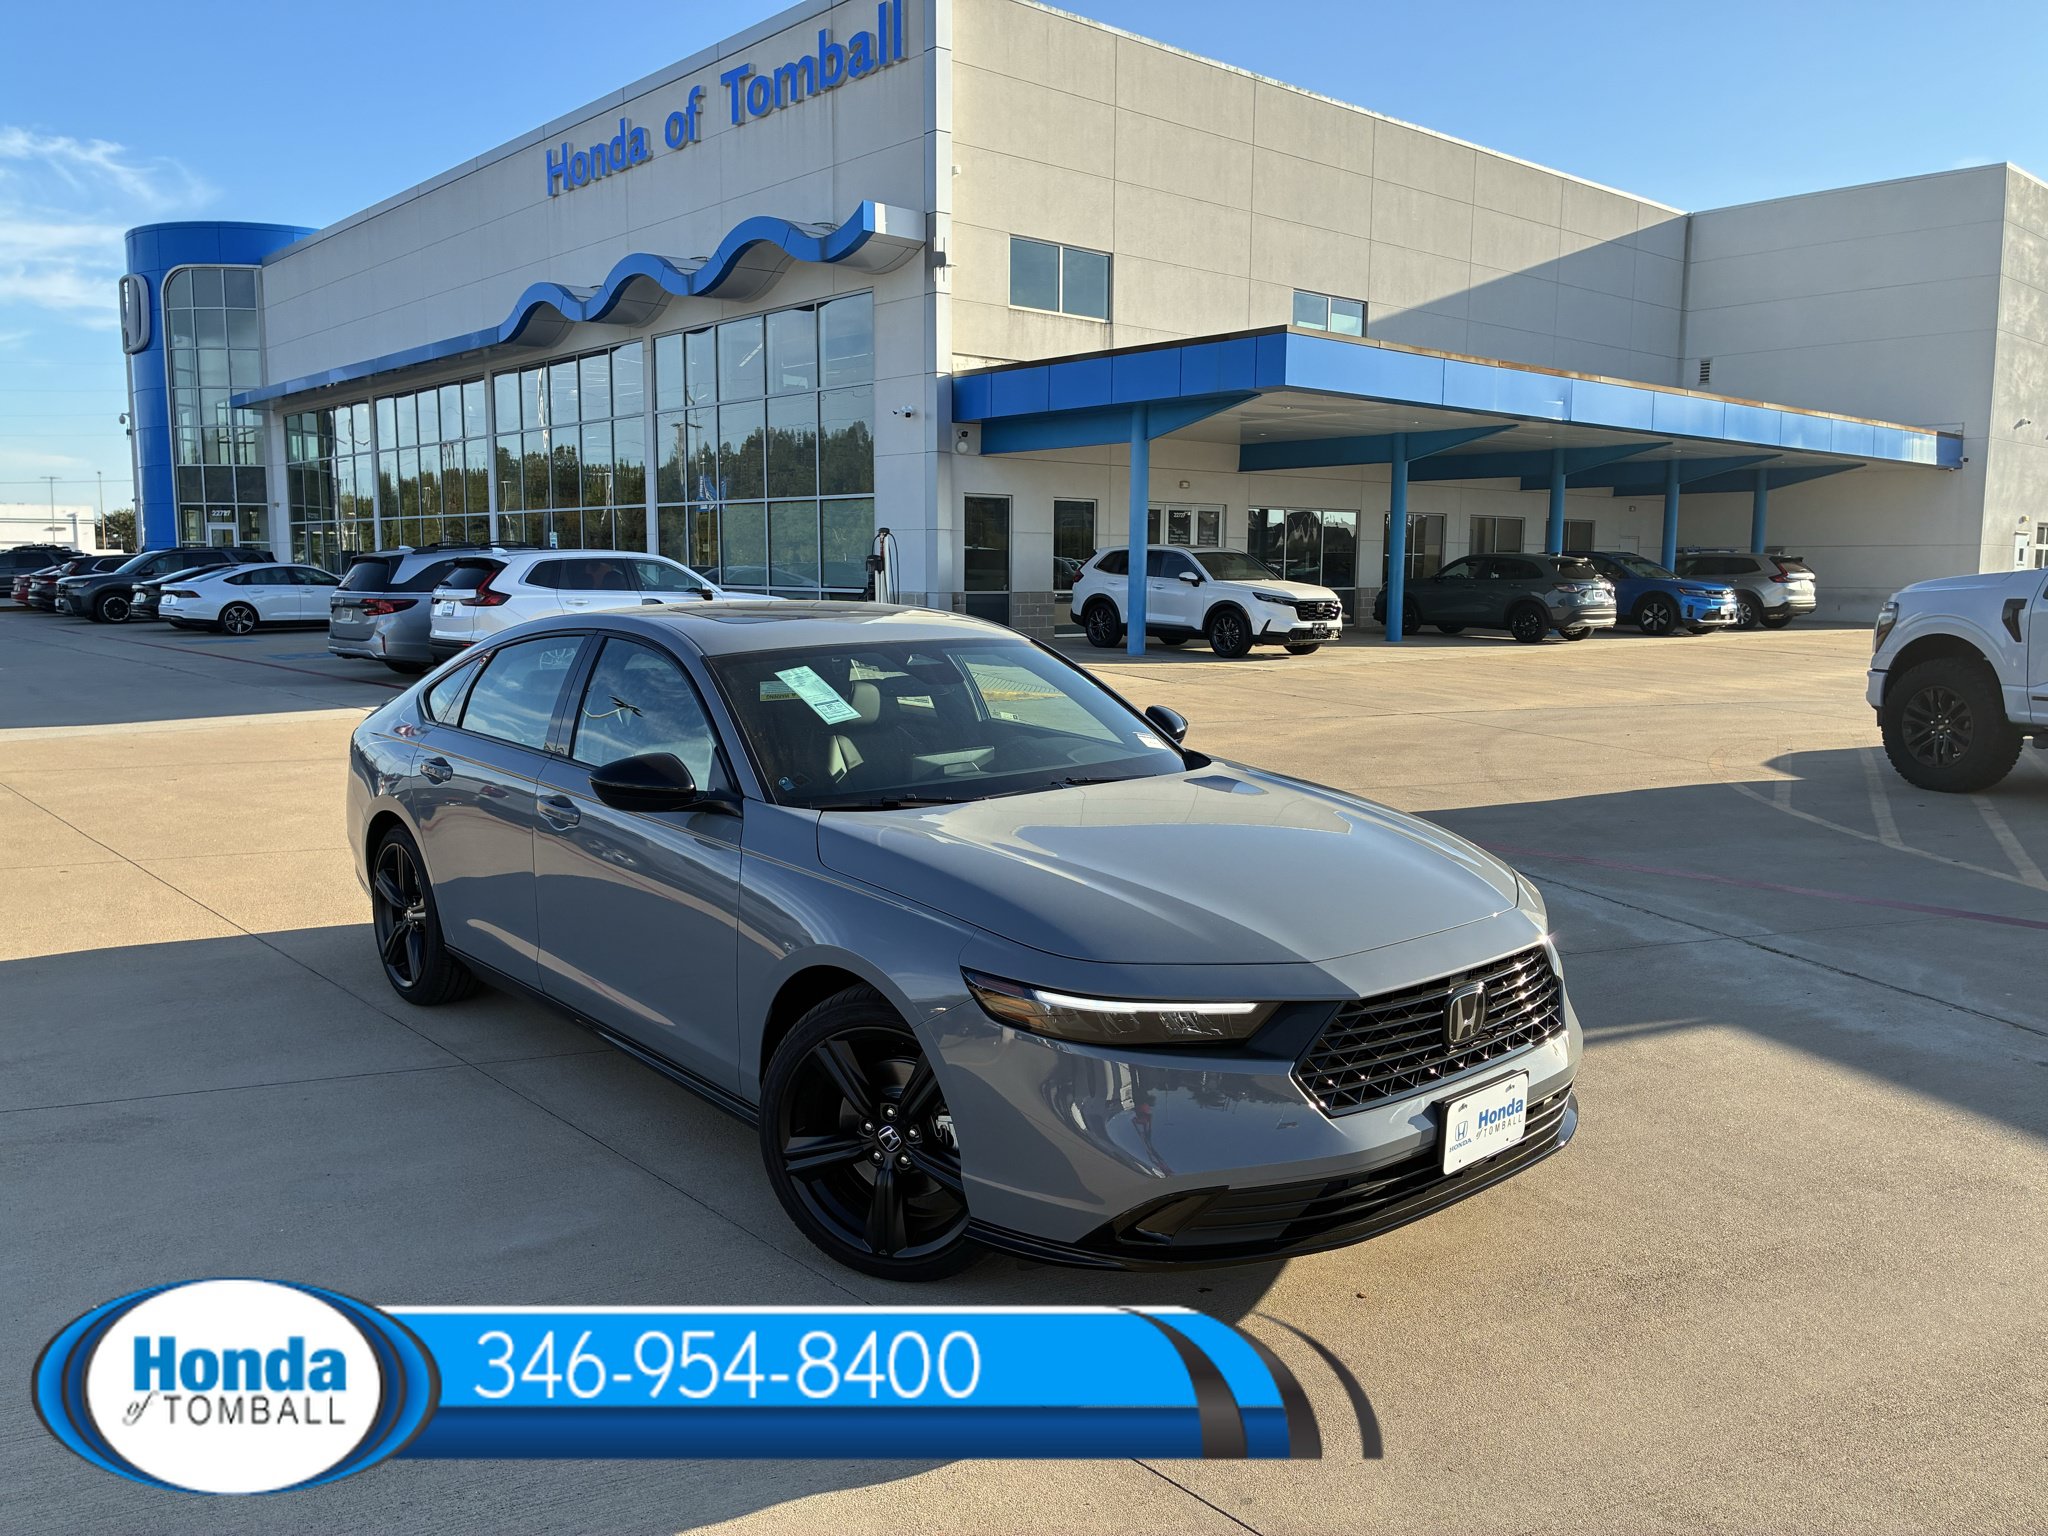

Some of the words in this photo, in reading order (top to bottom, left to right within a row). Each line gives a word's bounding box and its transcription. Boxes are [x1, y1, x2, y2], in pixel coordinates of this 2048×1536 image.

[546, 117, 652, 197] Honda
[664, 84, 706, 150] of
[720, 0, 908, 126] Tomball
[1478, 1098, 1524, 1129] Honda
[1484, 1115, 1521, 1137] TOMBALL
[1449, 1138, 1472, 1152] HONDA
